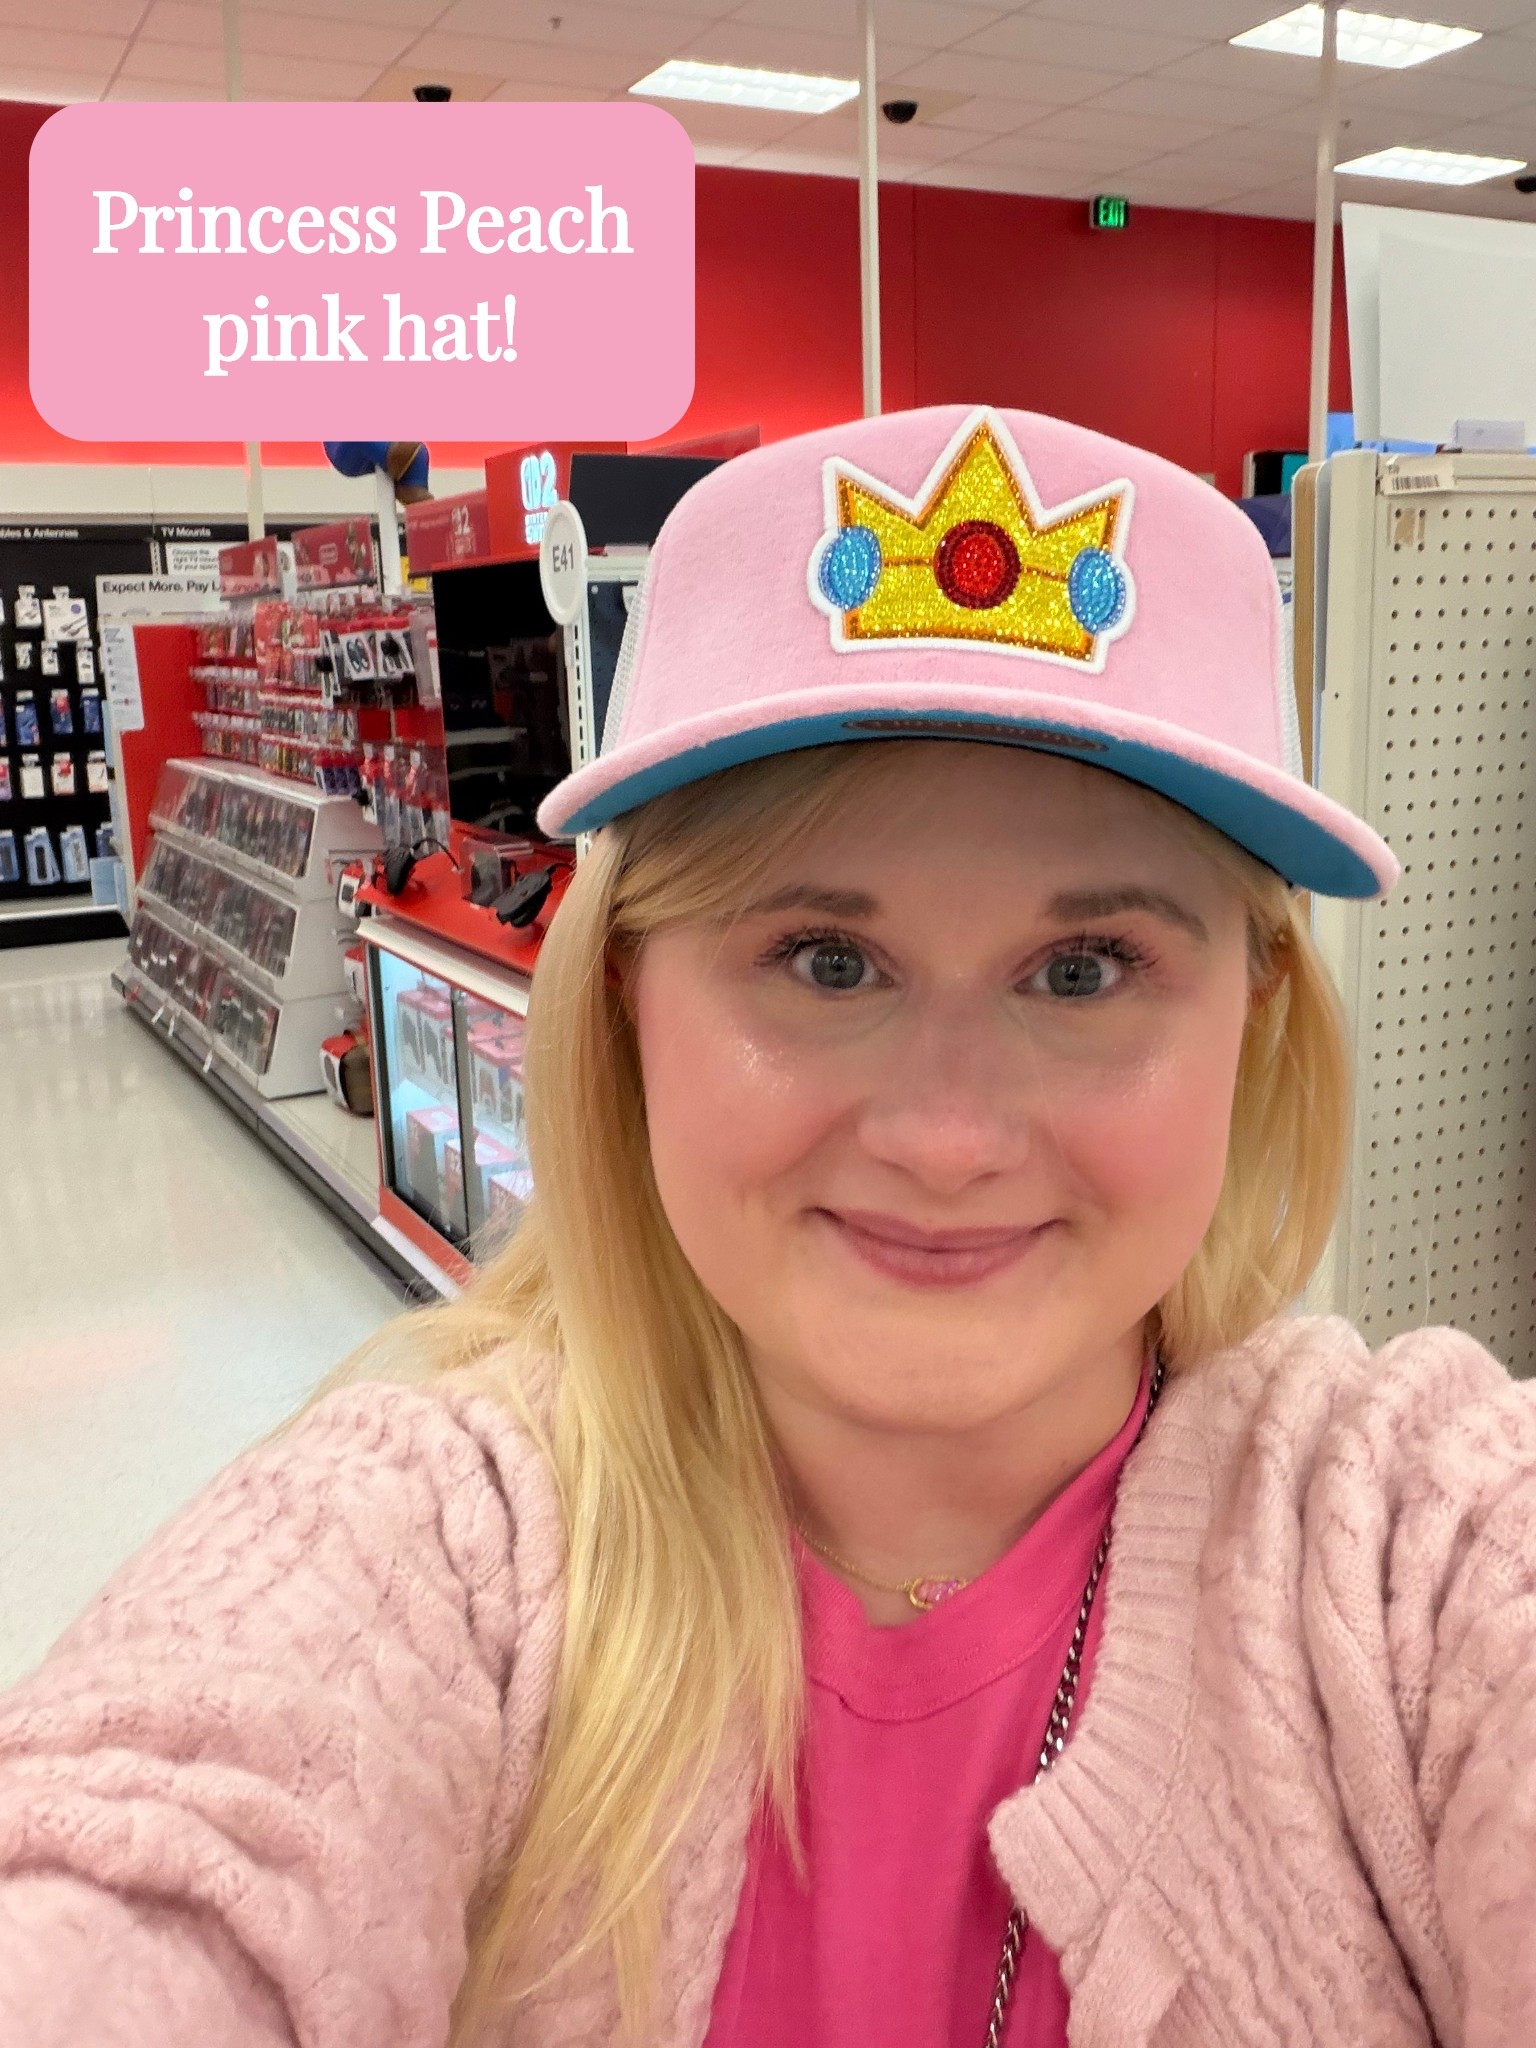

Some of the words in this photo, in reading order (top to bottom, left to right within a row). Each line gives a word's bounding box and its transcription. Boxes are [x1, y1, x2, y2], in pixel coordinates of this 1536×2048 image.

[1100, 199, 1124, 227] EXIT
[23, 527, 32, 538] &
[161, 526, 175, 538] TV
[176, 526, 212, 538] Mounts
[552, 543, 575, 573] E41
[102, 581, 146, 595] Expect
[150, 580, 183, 593] More.
[187, 580, 208, 594] Pay
